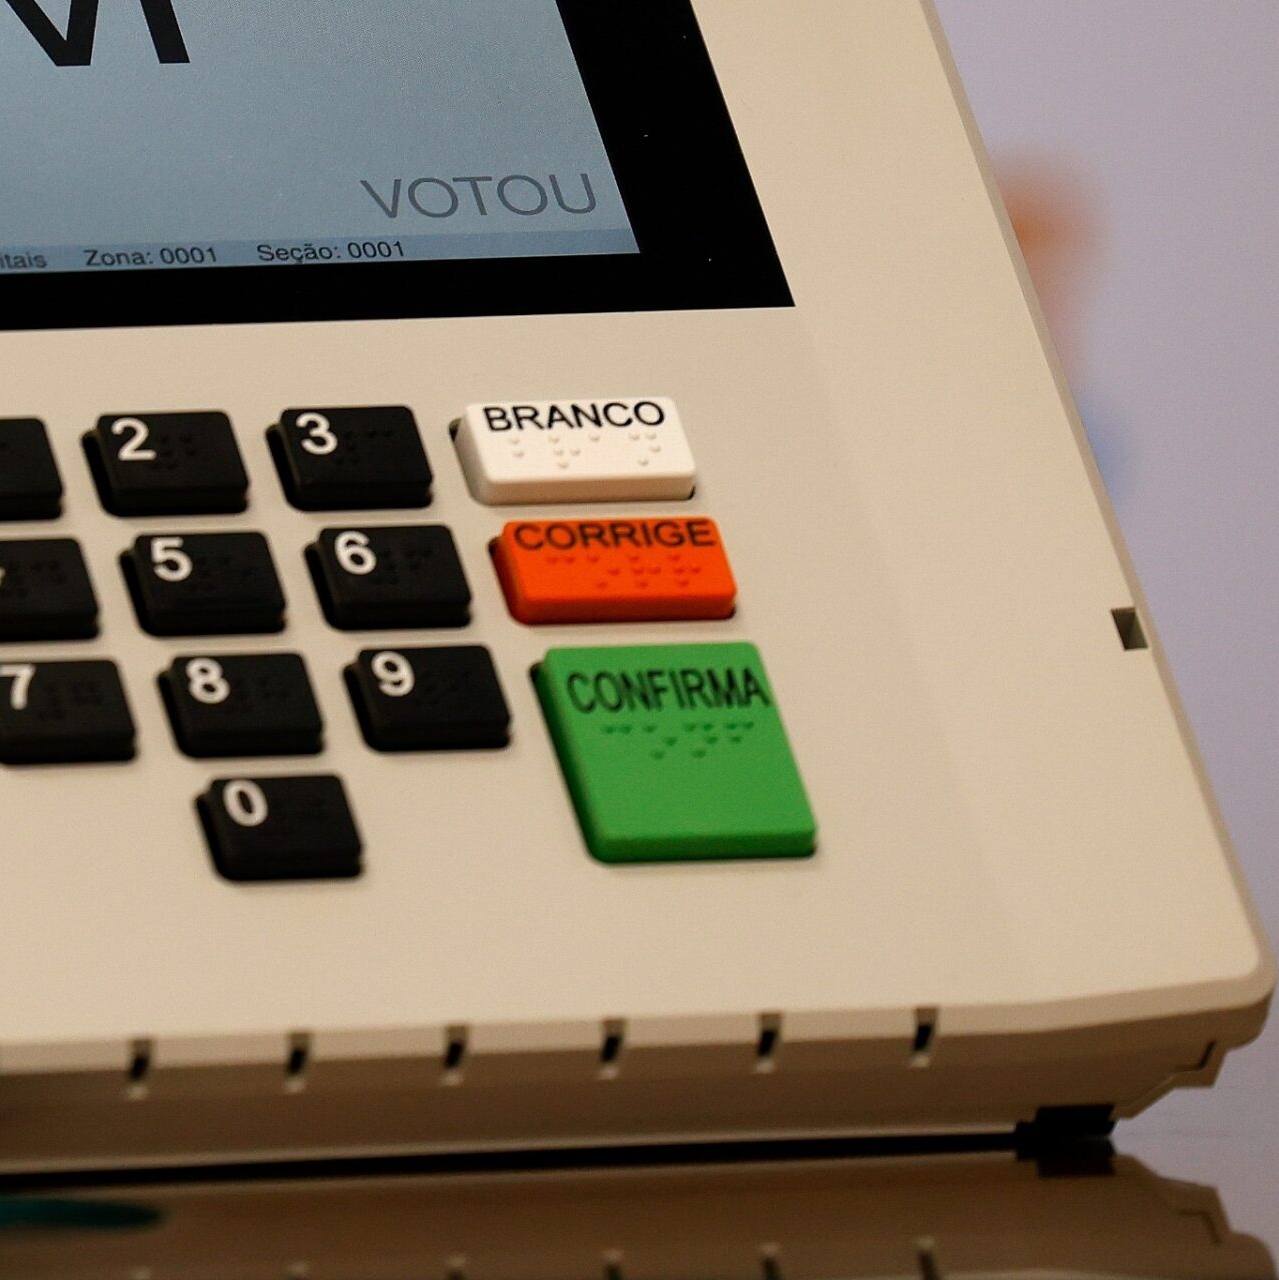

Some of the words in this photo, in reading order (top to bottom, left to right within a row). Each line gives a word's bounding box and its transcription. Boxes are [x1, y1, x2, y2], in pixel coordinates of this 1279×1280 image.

[360, 172, 598, 220] VOTOU
[83, 248, 155, 268] Zona:
[159, 246, 218, 266] 0001
[256, 242, 342, 266] Seção:
[346, 240, 406, 261] 0001
[296, 412, 338, 455] 3
[482, 400, 666, 433] BRANCO
[111, 418, 157, 461] 2
[334, 530, 377, 575] 6
[512, 519, 717, 552] CORRIGE
[150, 536, 193, 582] 5
[185, 657, 231, 705] 8
[371, 651, 416, 697] 9
[565, 665, 771, 716] CONFIRMA
[222, 779, 269, 827] 0
